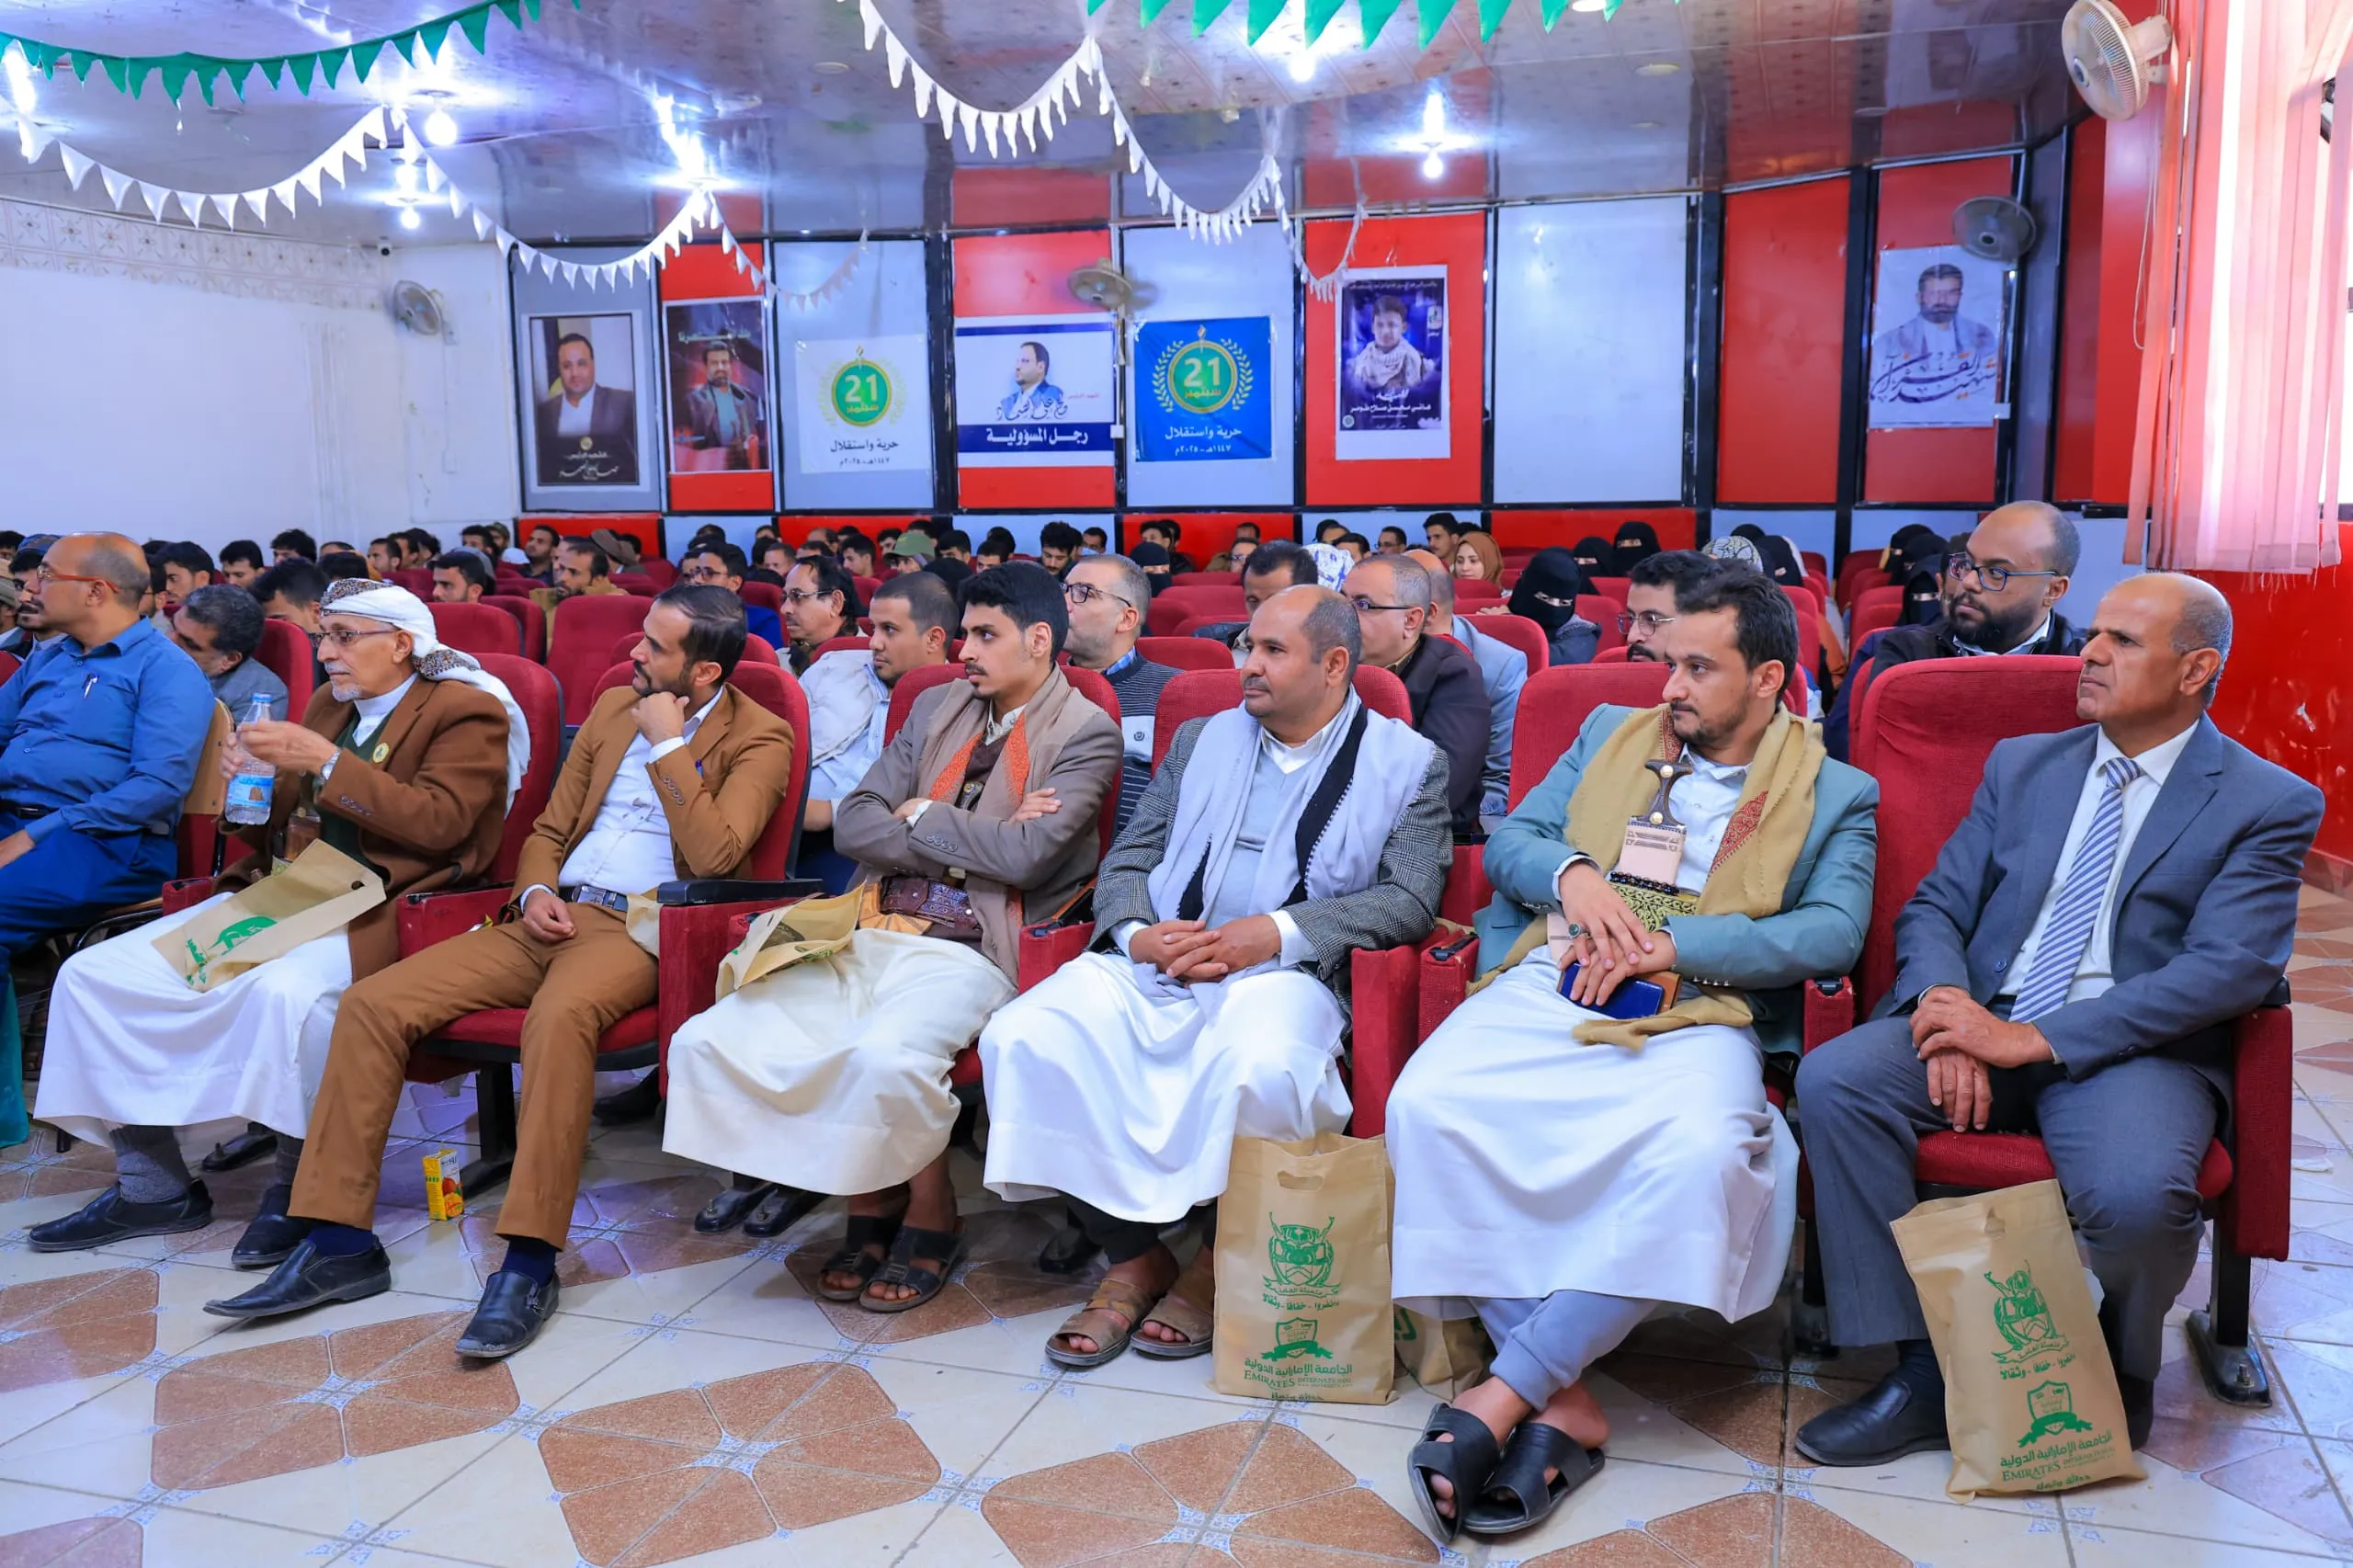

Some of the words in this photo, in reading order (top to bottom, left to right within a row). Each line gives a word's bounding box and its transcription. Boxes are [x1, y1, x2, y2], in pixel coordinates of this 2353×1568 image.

[1184, 357, 1220, 387] 21
[845, 373, 878, 403] 21
[986, 426, 1047, 447] المسؤولية
[1048, 427, 1088, 445] رجل
[1165, 426, 1213, 440] واستقلال
[1216, 425, 1242, 439] حرية
[830, 440, 874, 452] واستقلال
[876, 438, 899, 451] حرية
[1245, 1358, 1274, 1375] الدولية
[1275, 1364, 1313, 1377] الإماراتية
[1315, 1364, 1353, 1375] الجامعة
[1244, 1369, 1295, 1390] EMIRATES
[2078, 1429, 2113, 1450] الجامعة
[2000, 1448, 2035, 1468] الدولية
[2036, 1440, 2077, 1460] الإماراتية
[2002, 1460, 2061, 1482] EMIRATES
